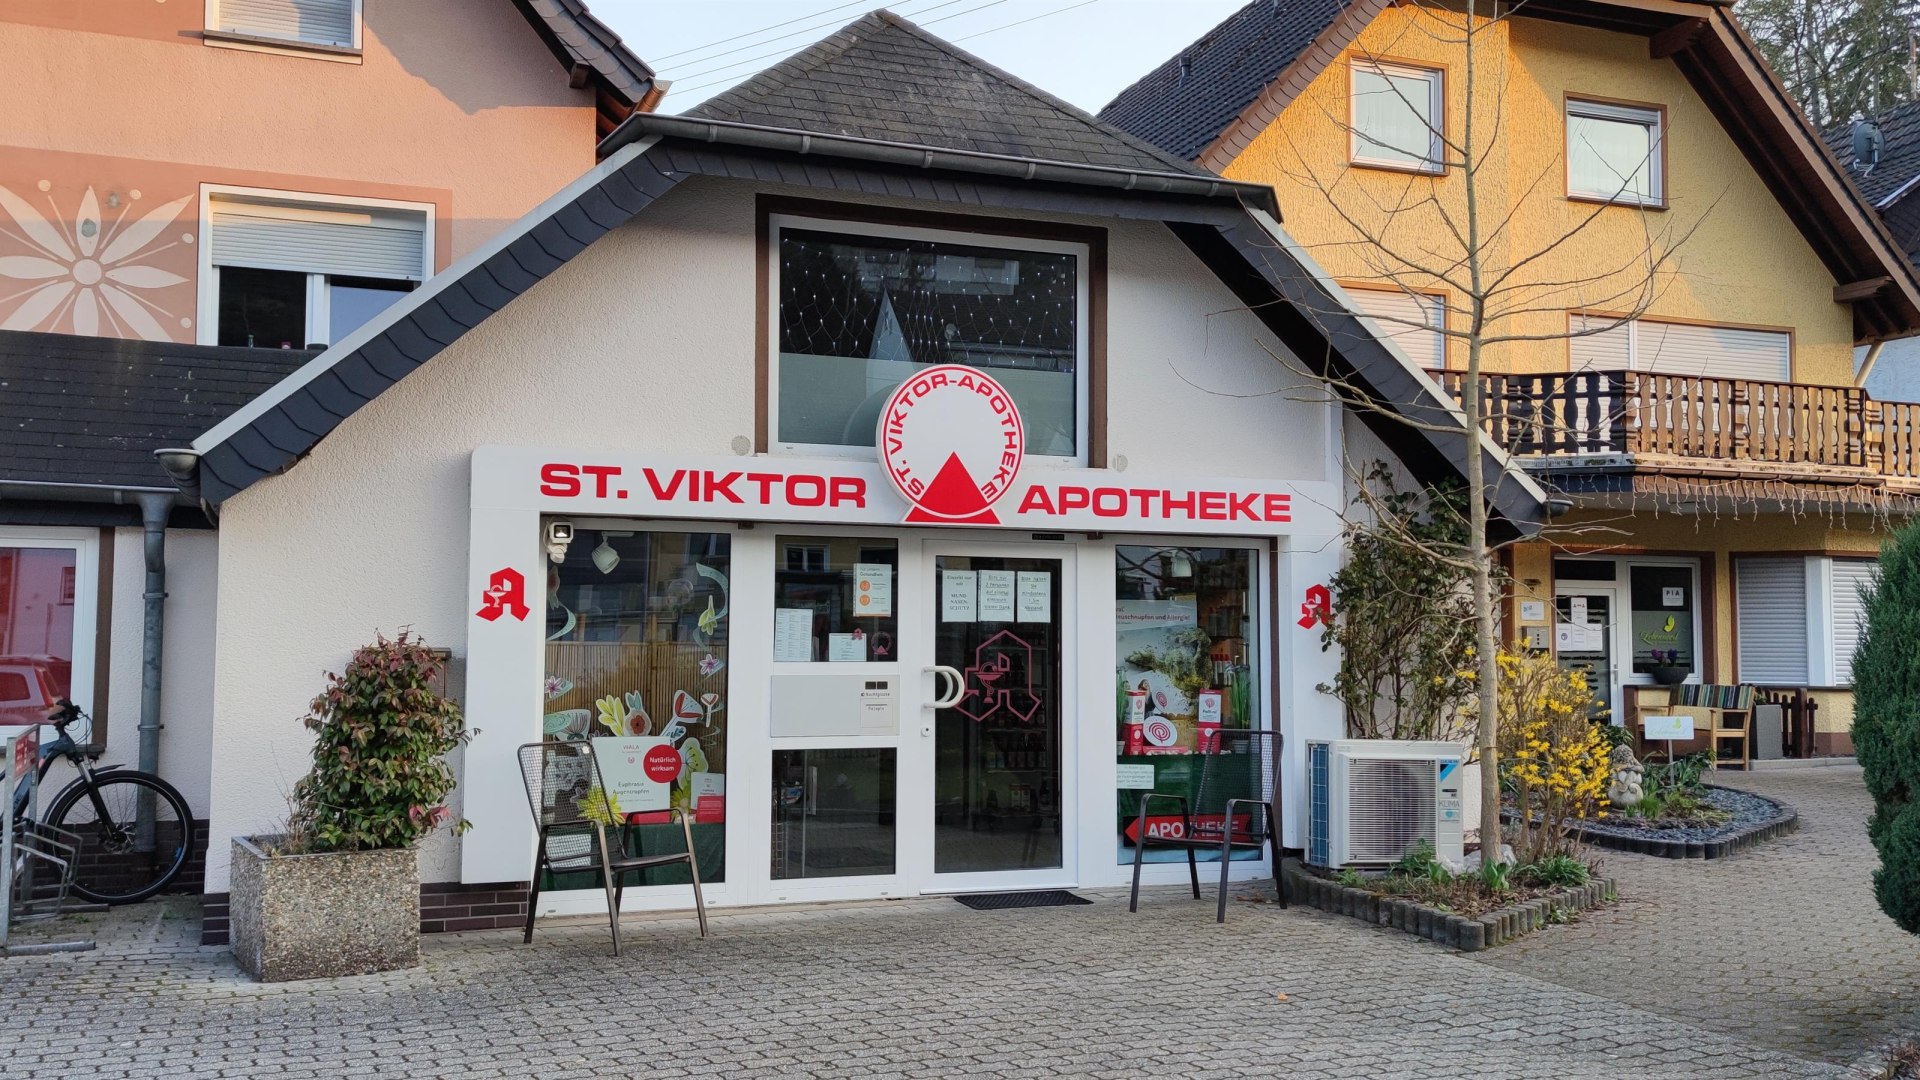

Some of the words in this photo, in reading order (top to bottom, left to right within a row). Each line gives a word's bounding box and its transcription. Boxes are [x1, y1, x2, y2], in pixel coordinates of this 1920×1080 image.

[889, 373, 1018, 499] VIKTOR-APOTHEKE
[540, 464, 628, 499] ST.
[643, 468, 867, 508] VIKTOR
[1018, 485, 1291, 522] APOTHEKE
[895, 459, 925, 496] ST.
[649, 756, 676, 764] Natürlich
[1148, 820, 1240, 838] APOHEK
